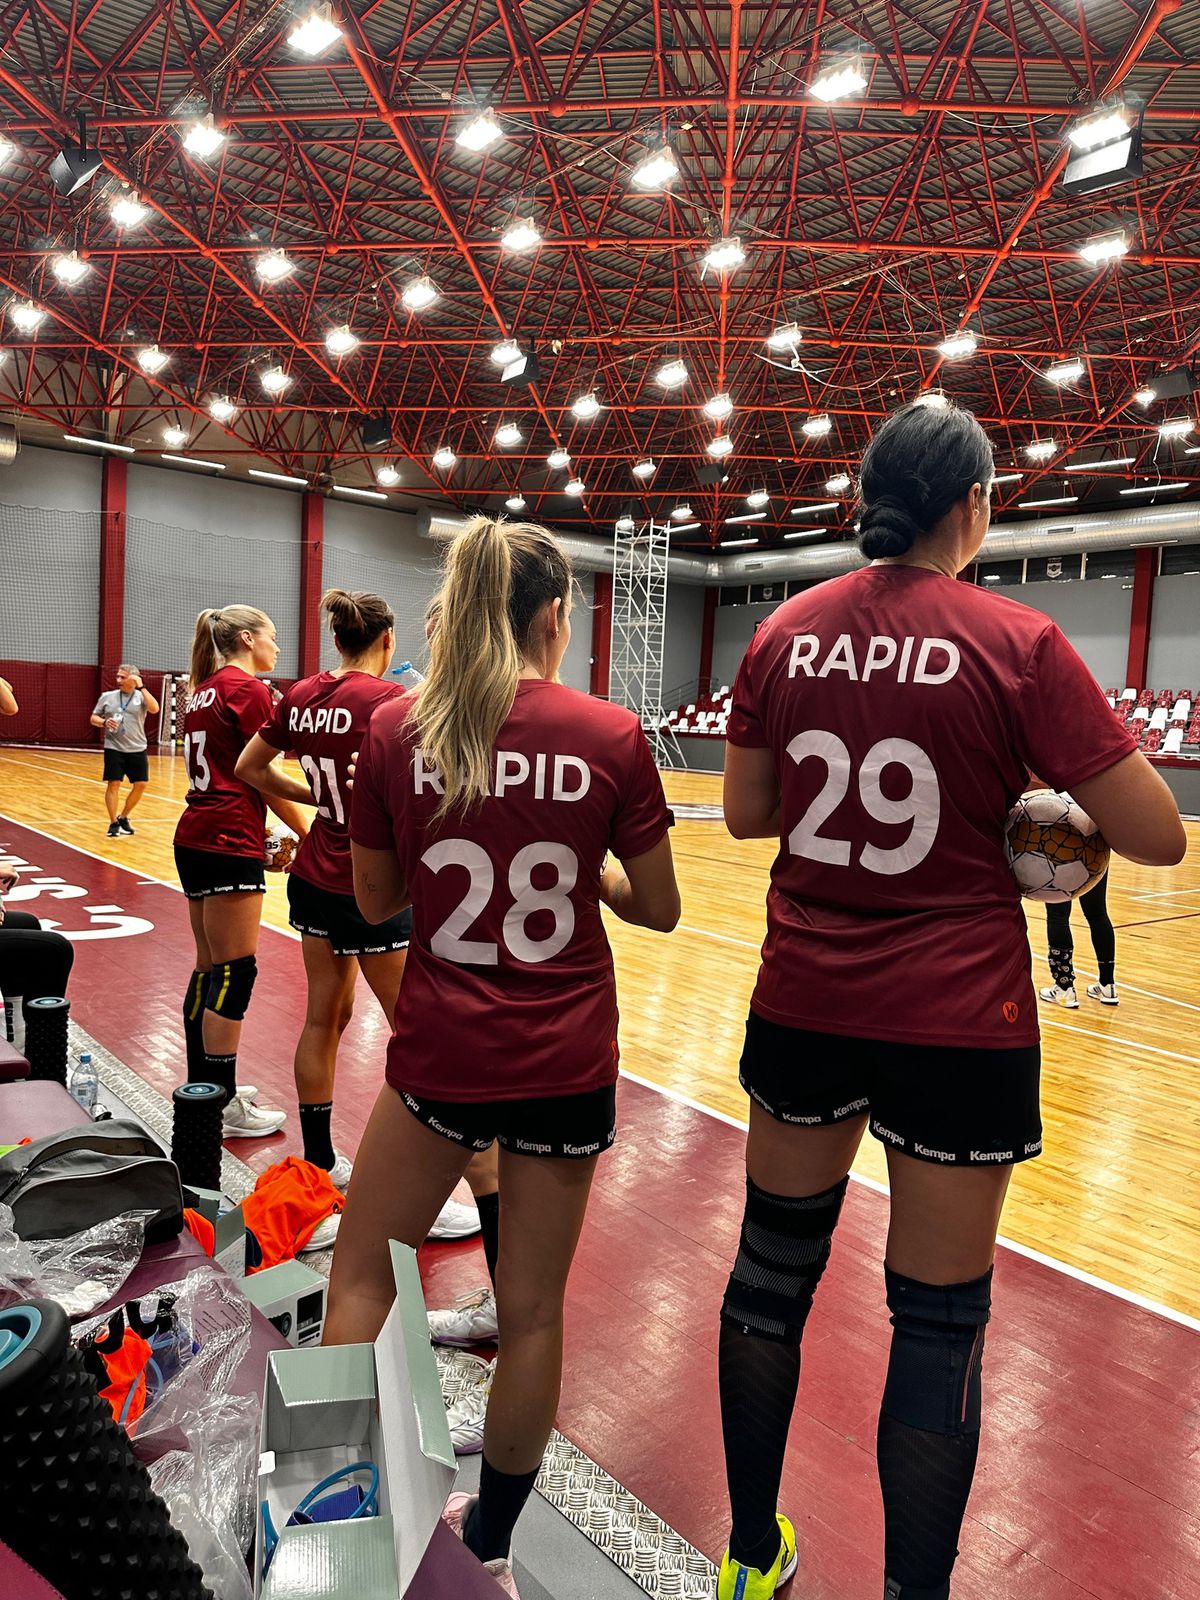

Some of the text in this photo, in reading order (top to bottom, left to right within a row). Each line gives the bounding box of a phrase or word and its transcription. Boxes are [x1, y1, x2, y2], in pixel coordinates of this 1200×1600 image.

[788, 633, 961, 685] RAPID
[288, 706, 352, 734] RAPID
[301, 755, 345, 825] 21
[785, 729, 941, 875] 29
[420, 838, 578, 965] 28
[392, 940, 410, 949] Kemp
[427, 1116, 464, 1141] Kempa
[782, 1112, 822, 1125] Kempa
[832, 1097, 869, 1119] Kempa
[516, 1138, 552, 1154] Kempa
[563, 1141, 600, 1155] Kempa
[872, 1120, 905, 1146] Kempa
[914, 1142, 956, 1162] Kempa
[969, 1150, 1014, 1163] Kempa
